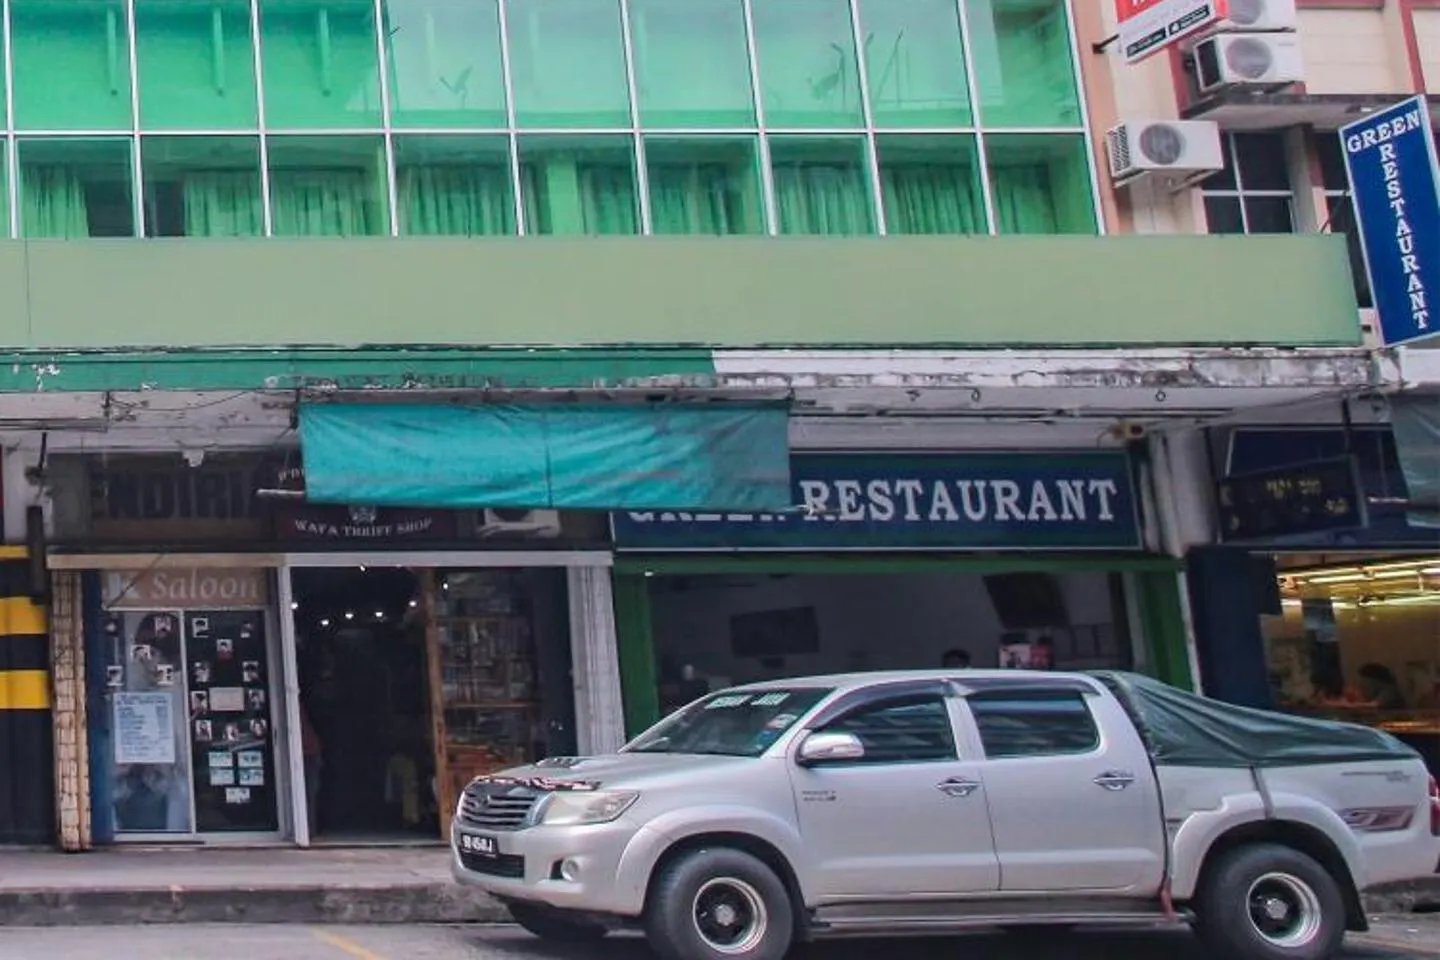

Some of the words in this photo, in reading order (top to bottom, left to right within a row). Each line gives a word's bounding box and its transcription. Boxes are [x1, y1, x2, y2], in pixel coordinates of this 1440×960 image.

[1347, 109, 1420, 153] GREEN
[1378, 142, 1429, 330] RESTAURANT
[799, 478, 1118, 522] RESTAURANT
[295, 519, 339, 537] WAFA
[344, 524, 392, 537] THRIFT
[397, 517, 433, 534] SHOP
[150, 568, 259, 600] Saloon
